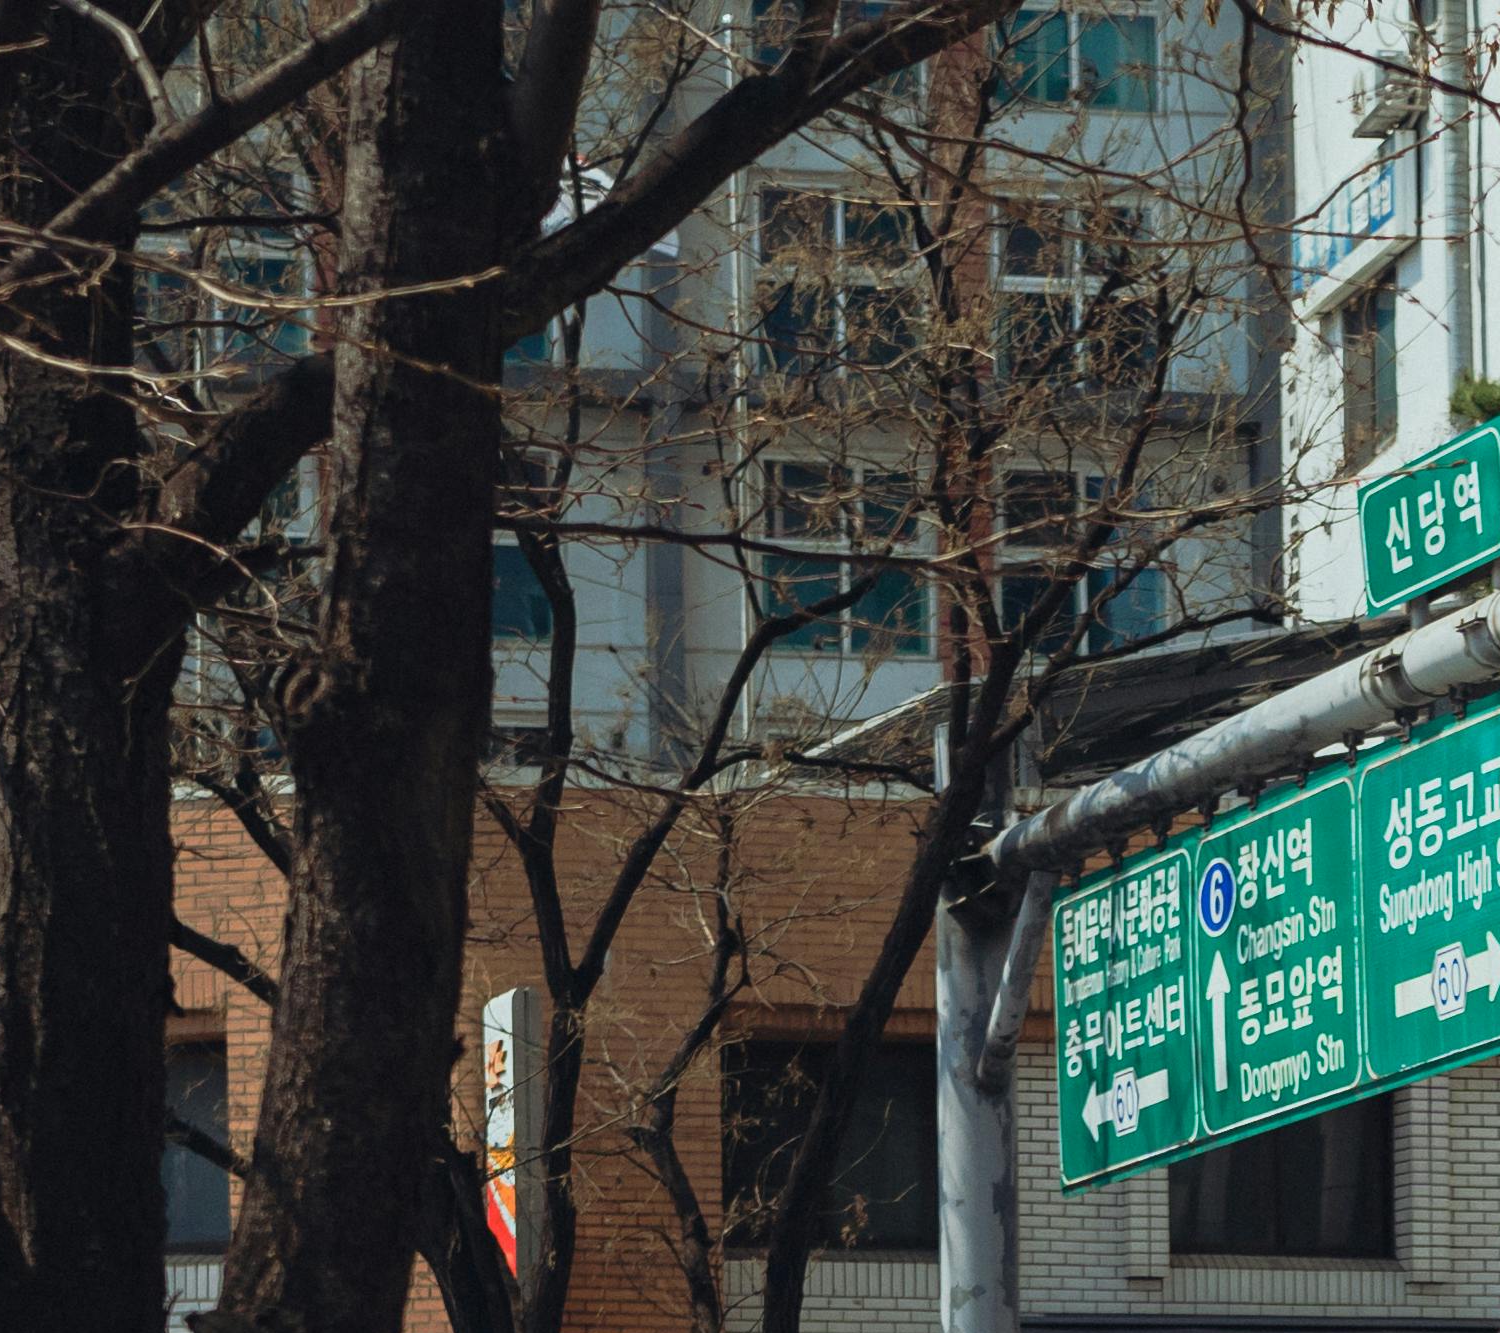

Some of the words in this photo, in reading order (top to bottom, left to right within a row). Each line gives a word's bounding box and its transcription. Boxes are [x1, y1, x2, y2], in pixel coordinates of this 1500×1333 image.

[1386, 461, 1483, 574] 신당역
[1208, 869, 1224, 922] 6
[1237, 818, 1313, 909] 창신역
[1380, 868, 1453, 935] Sungdong
[1458, 848, 1493, 905] High
[1062, 861, 1180, 972] 동대문역사문화공원
[1237, 906, 1305, 965] Changsin
[1308, 895, 1336, 941] Stn
[1237, 945, 1344, 1046] 동묘앞역
[1437, 956, 1462, 1008] 60
[1064, 975, 1186, 1077] 충무아트센터
[1240, 1051, 1311, 1102] Dongmyo
[1317, 1033, 1345, 1076] Stn
[1116, 1081, 1137, 1124] 60
